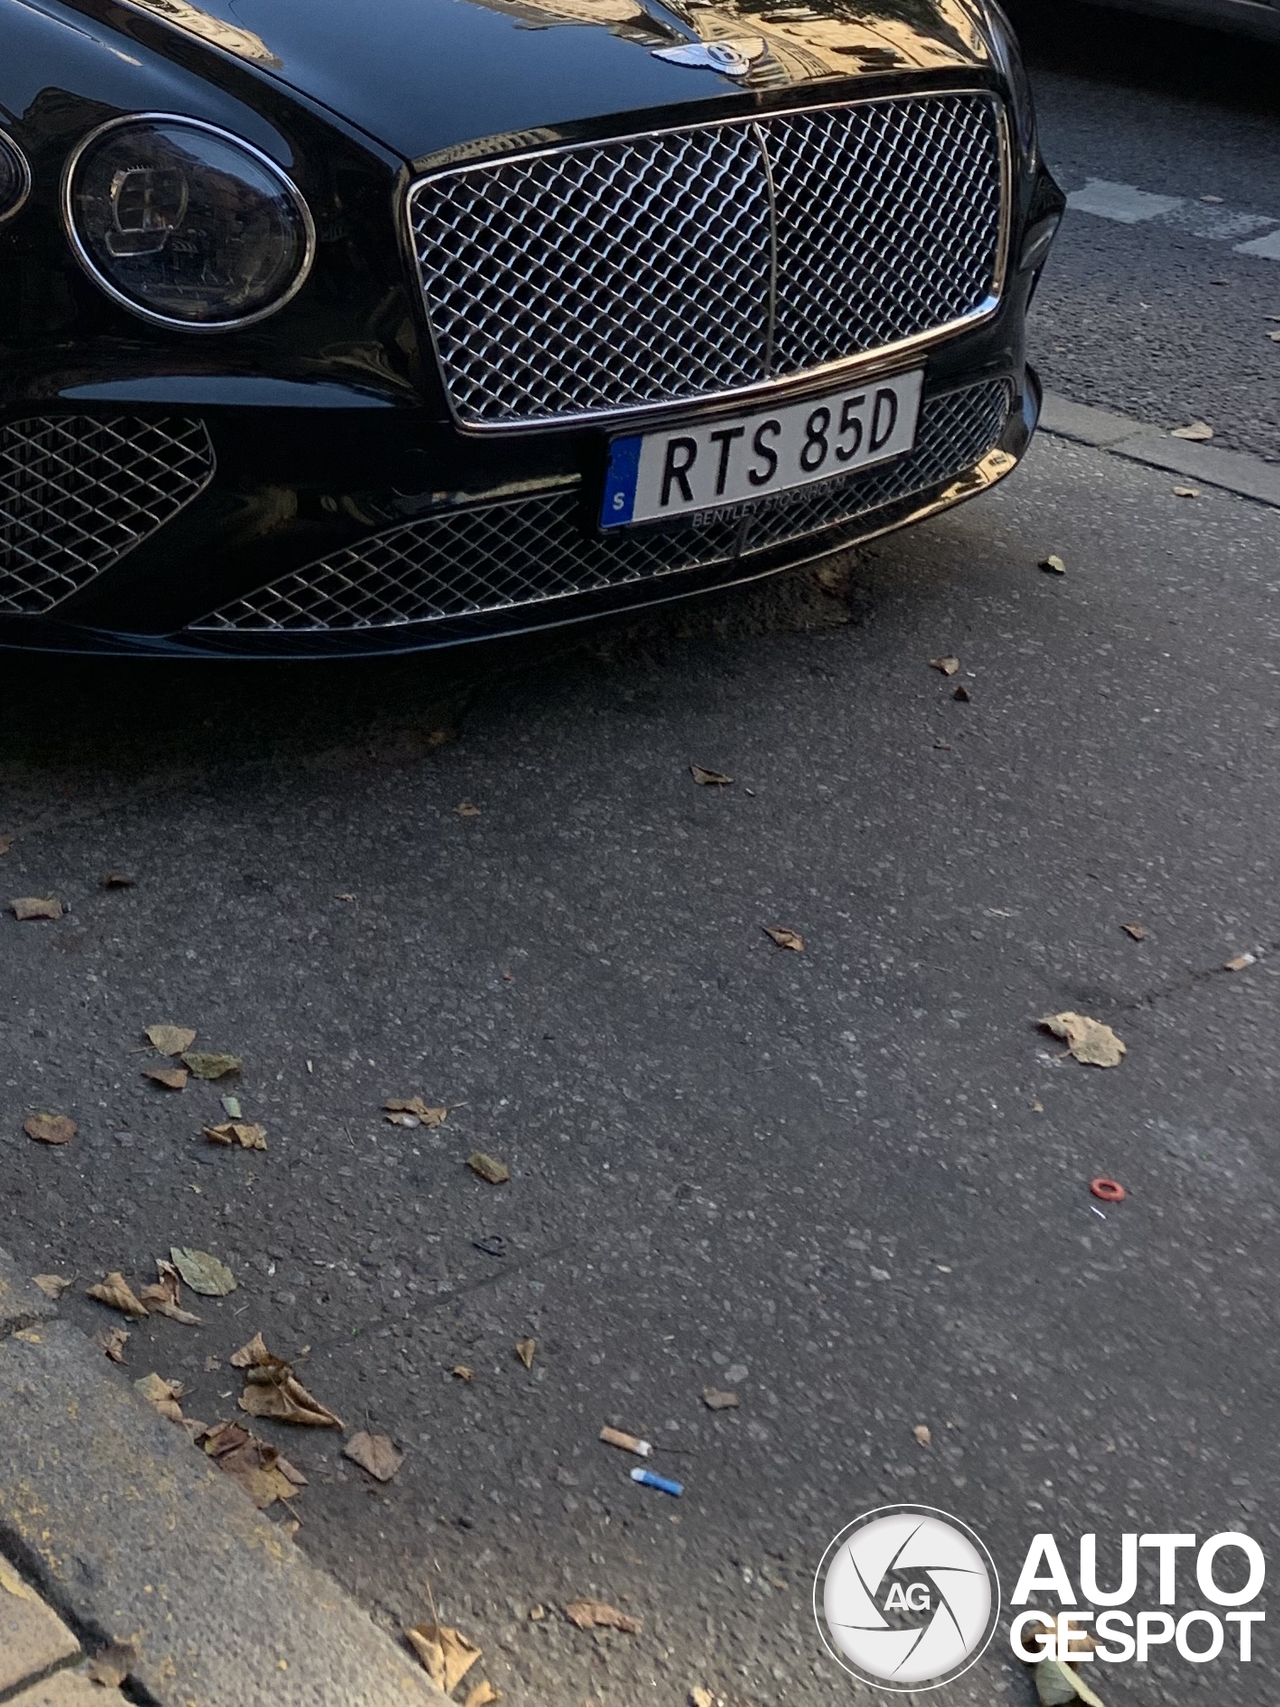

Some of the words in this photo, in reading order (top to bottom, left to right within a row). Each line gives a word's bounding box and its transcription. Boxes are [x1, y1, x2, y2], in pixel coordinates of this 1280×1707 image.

[659, 419, 782, 507] RTS
[799, 387, 899, 473] 85D
[612, 492, 625, 511] S
[692, 501, 763, 528] BENTLEY
[765, 476, 846, 509] STOCKHOLM
